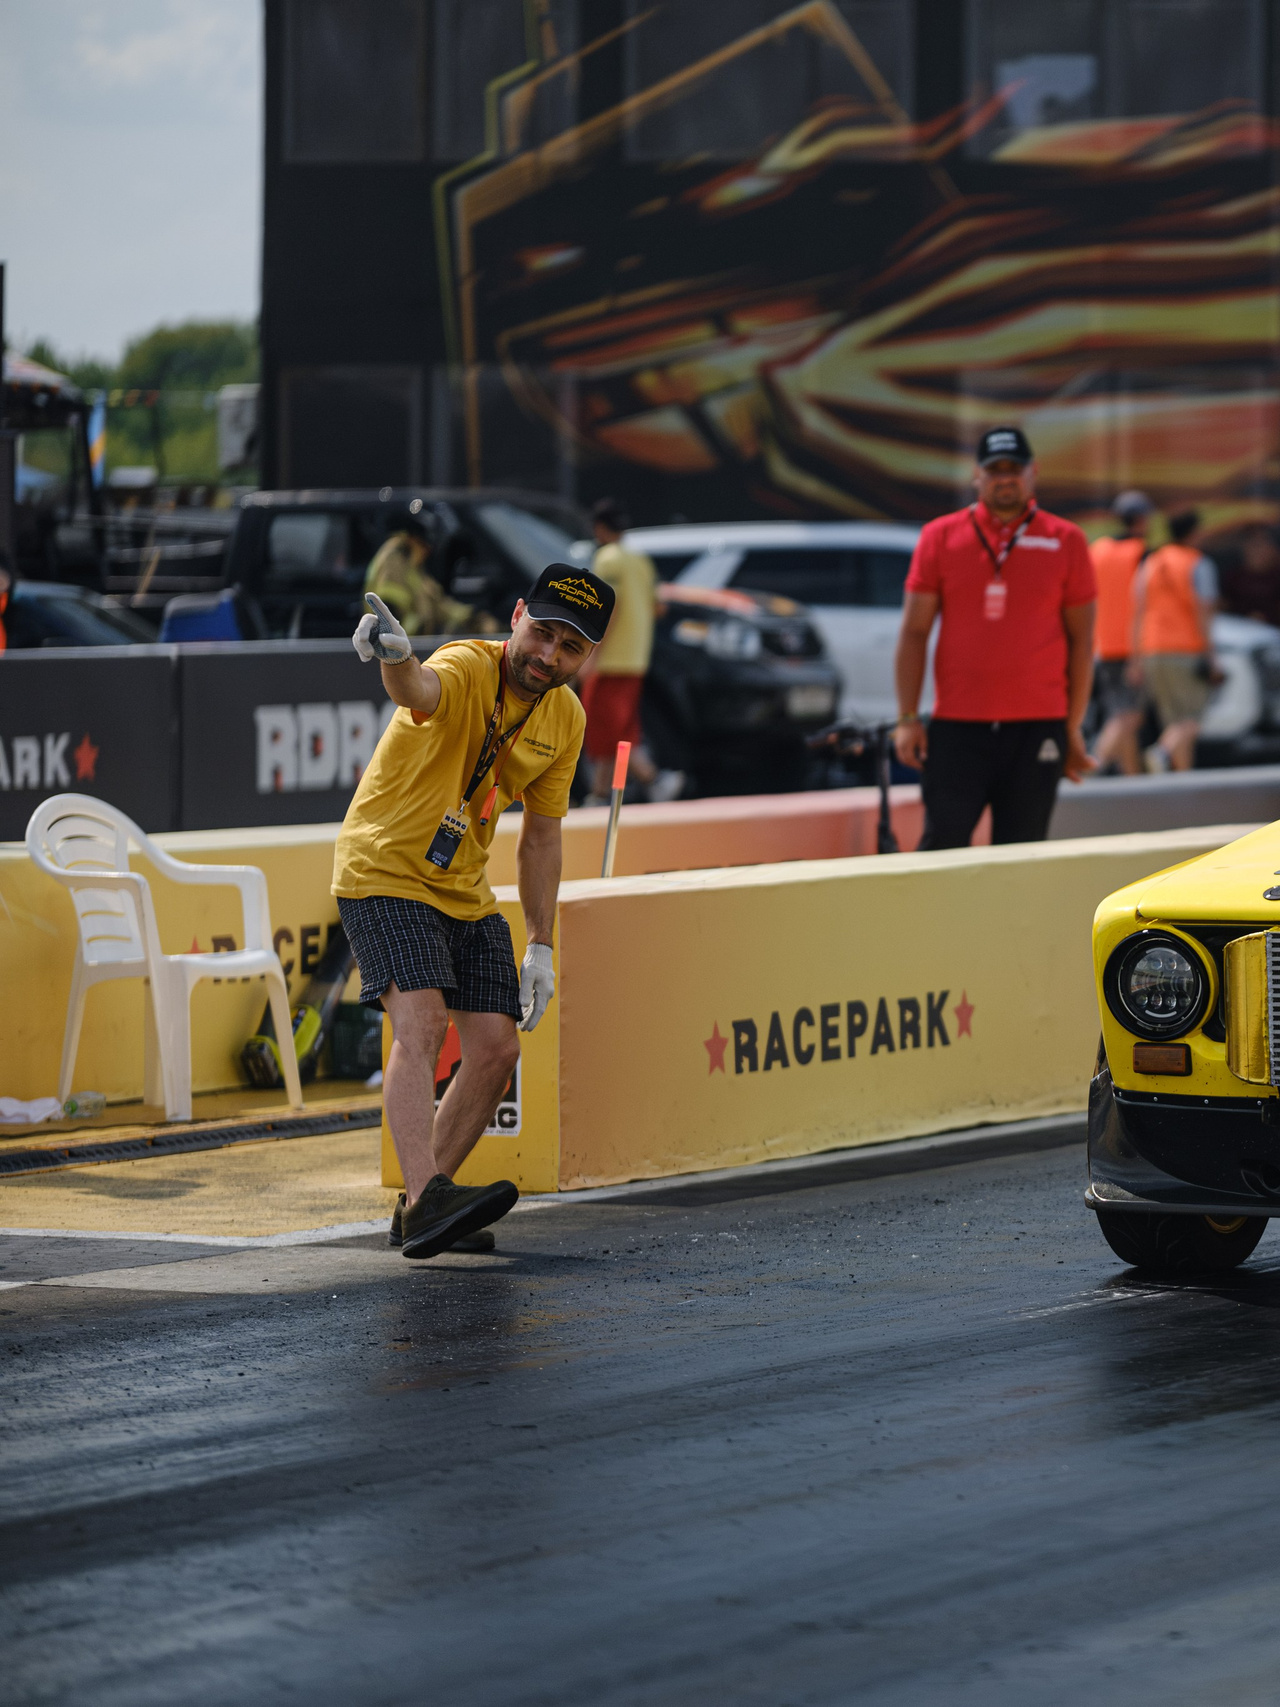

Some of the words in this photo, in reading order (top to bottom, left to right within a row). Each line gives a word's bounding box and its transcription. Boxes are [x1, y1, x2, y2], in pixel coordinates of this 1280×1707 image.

[548, 580, 603, 609] AGDASH
[559, 592, 589, 610] TEAM
[531, 748, 555, 760] TEAM
[732, 989, 951, 1075] RACEPARK
